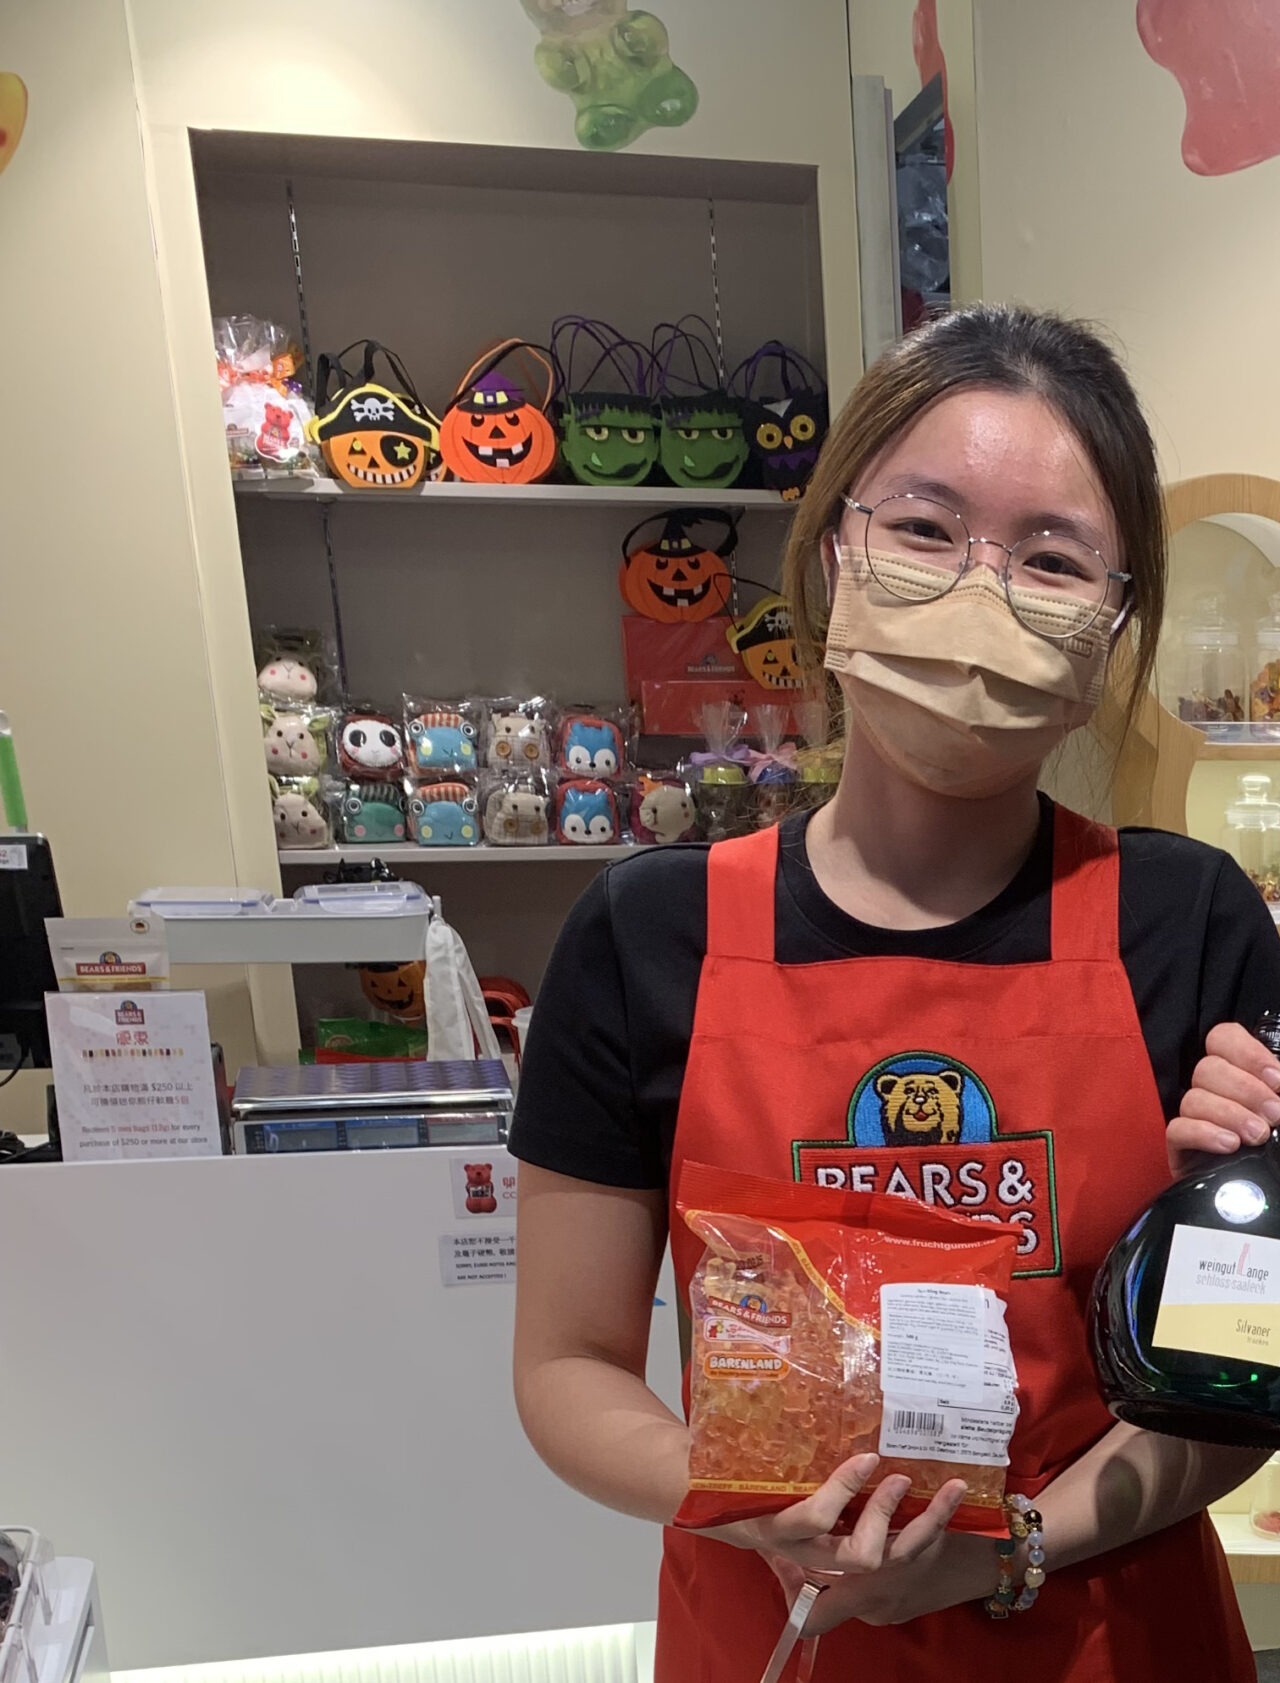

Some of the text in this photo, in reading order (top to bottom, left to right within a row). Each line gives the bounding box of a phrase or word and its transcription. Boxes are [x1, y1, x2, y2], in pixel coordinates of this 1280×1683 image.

[151, 1083, 173, 1092] $250
[171, 1124, 180, 1132] for
[182, 1125, 200, 1133] every
[79, 1139, 110, 1148] purchase
[112, 1138, 119, 1146] of
[121, 1138, 139, 1146] $250
[816, 1159, 1034, 1206] BEARS &
[1199, 1259, 1236, 1276] weingut
[712, 1300, 742, 1316] BEARS
[751, 1312, 787, 1324] FRIENDS
[1236, 1319, 1271, 1337] Silvaner
